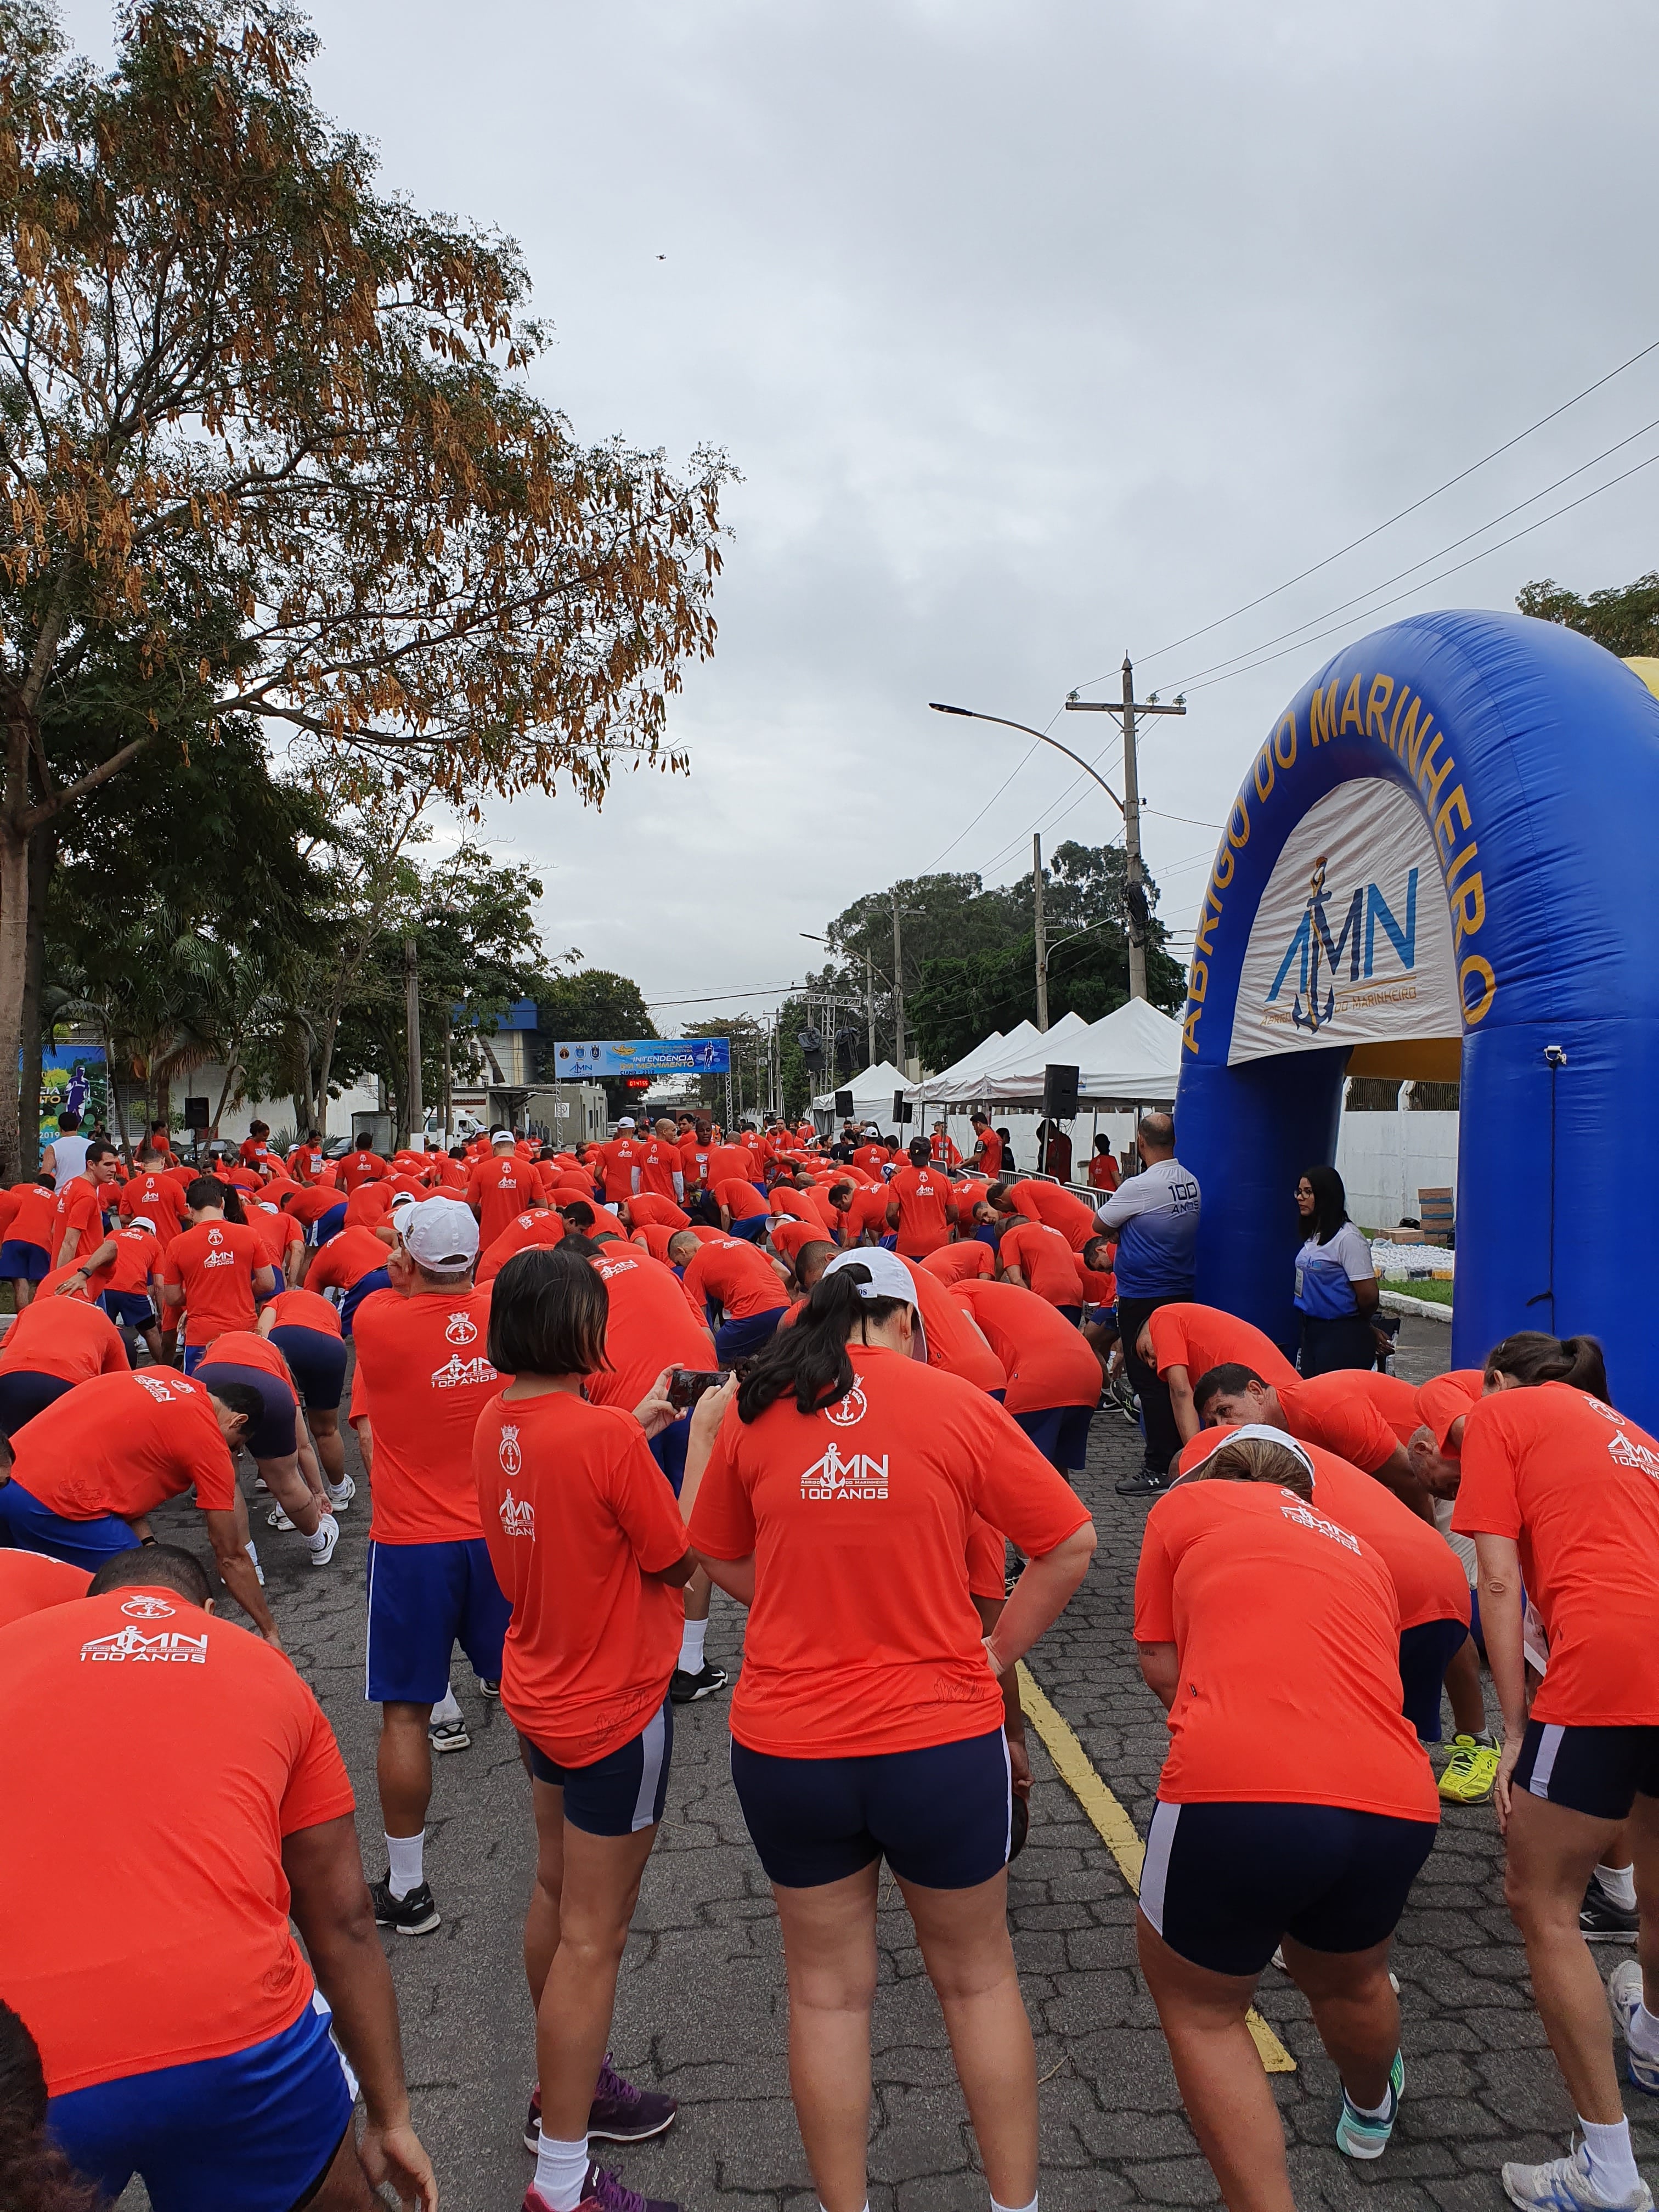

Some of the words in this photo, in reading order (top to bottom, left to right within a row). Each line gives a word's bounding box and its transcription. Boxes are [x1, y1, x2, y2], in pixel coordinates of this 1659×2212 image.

[1182, 802, 1251, 1055] ABRIGO
[1254, 712, 1297, 803] DO
[1310, 673, 1497, 1025] MARINHEIRO
[1260, 1012, 1291, 1026] ABRIGO
[1334, 1001, 1348, 1014] DO
[1352, 987, 1418, 1009] MARINHEIRO
[1168, 1182, 1197, 1201] 100
[1171, 1200, 1199, 1214] ANOS
[204, 1250, 234, 1262] AMN
[431, 1380, 456, 1388] 100
[460, 1373, 498, 1385] ANOS
[143, 1385, 163, 1403] ANOS
[800, 1448, 889, 1480] AMN
[1611, 1455, 1639, 1468] 100
[800, 1488, 832, 1499] 100
[837, 1488, 888, 1499] ANOS
[1282, 1511, 1314, 1529] 100
[1318, 1529, 1362, 1556] ANOS
[83, 1629, 208, 1650] AMN
[80, 1652, 126, 1662] 100
[132, 1653, 206, 1664] ANOS
